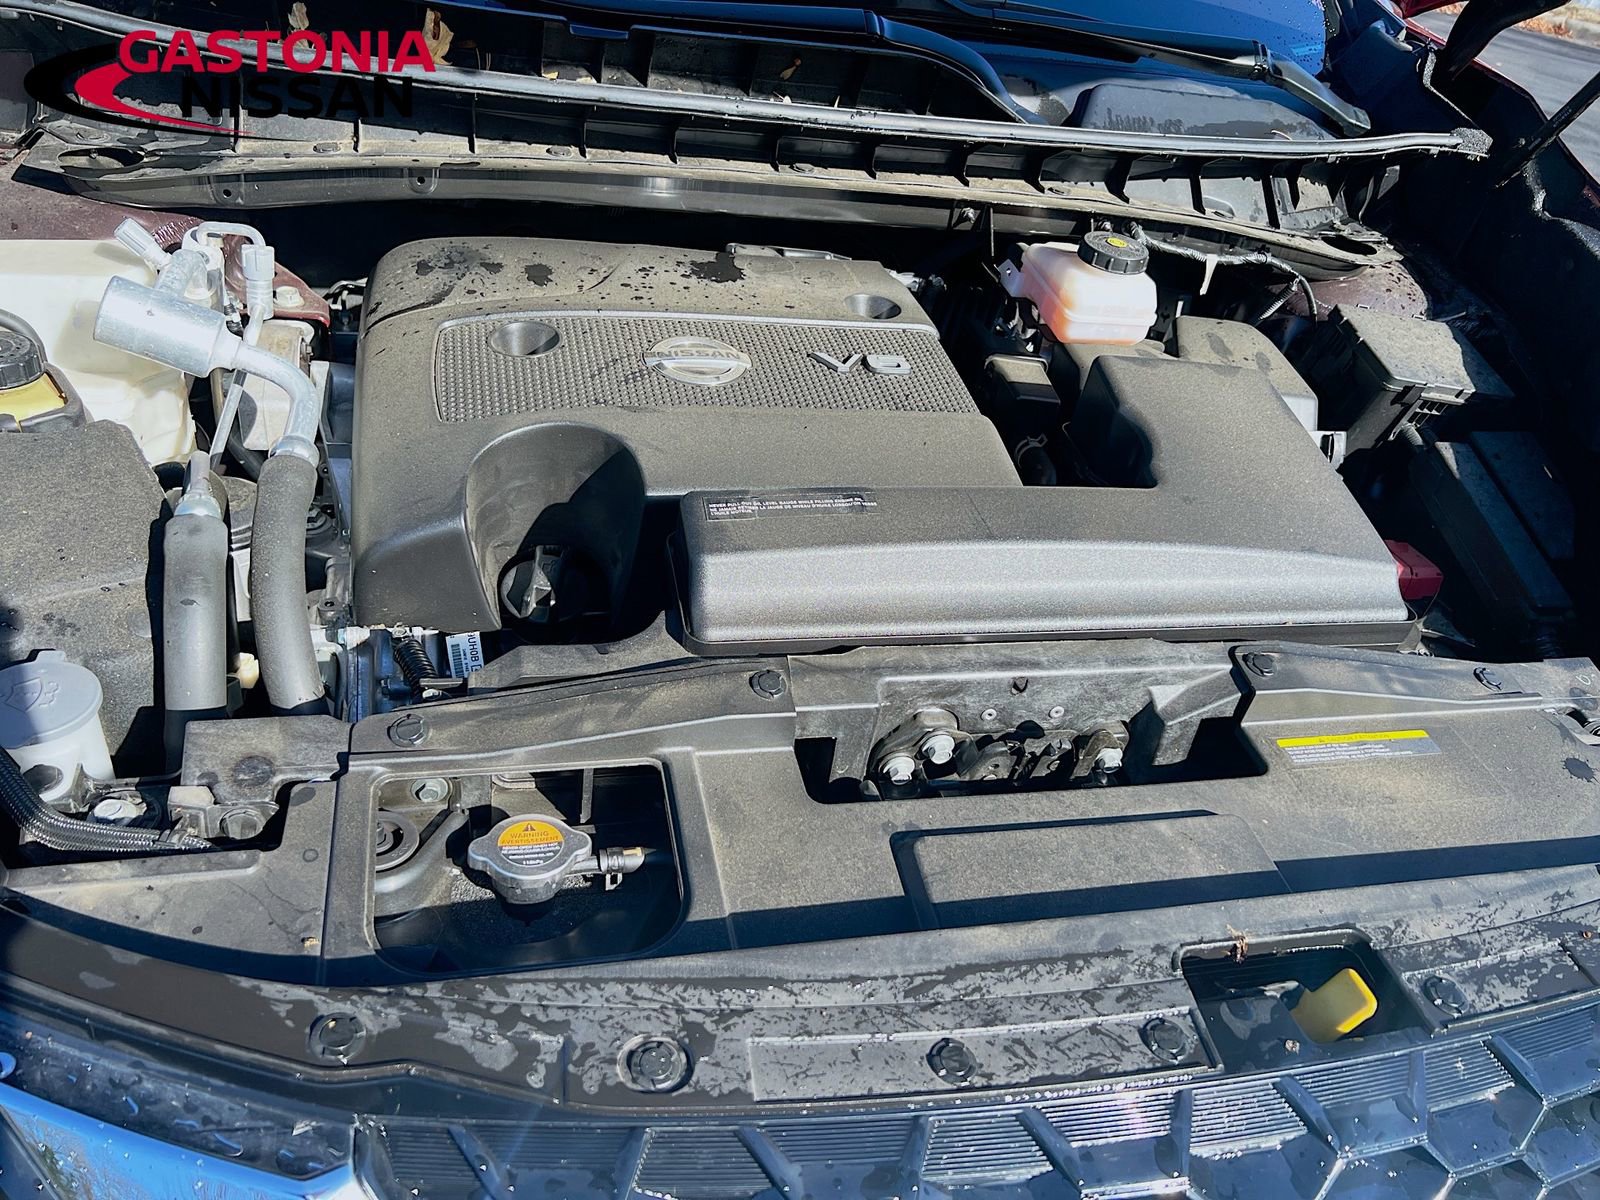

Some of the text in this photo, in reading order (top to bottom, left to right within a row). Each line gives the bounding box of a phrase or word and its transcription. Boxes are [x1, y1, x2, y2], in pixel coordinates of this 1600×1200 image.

[656, 349, 740, 359] NISSAN
[807, 351, 912, 375] V6
[510, 831, 549, 839] WARNING
